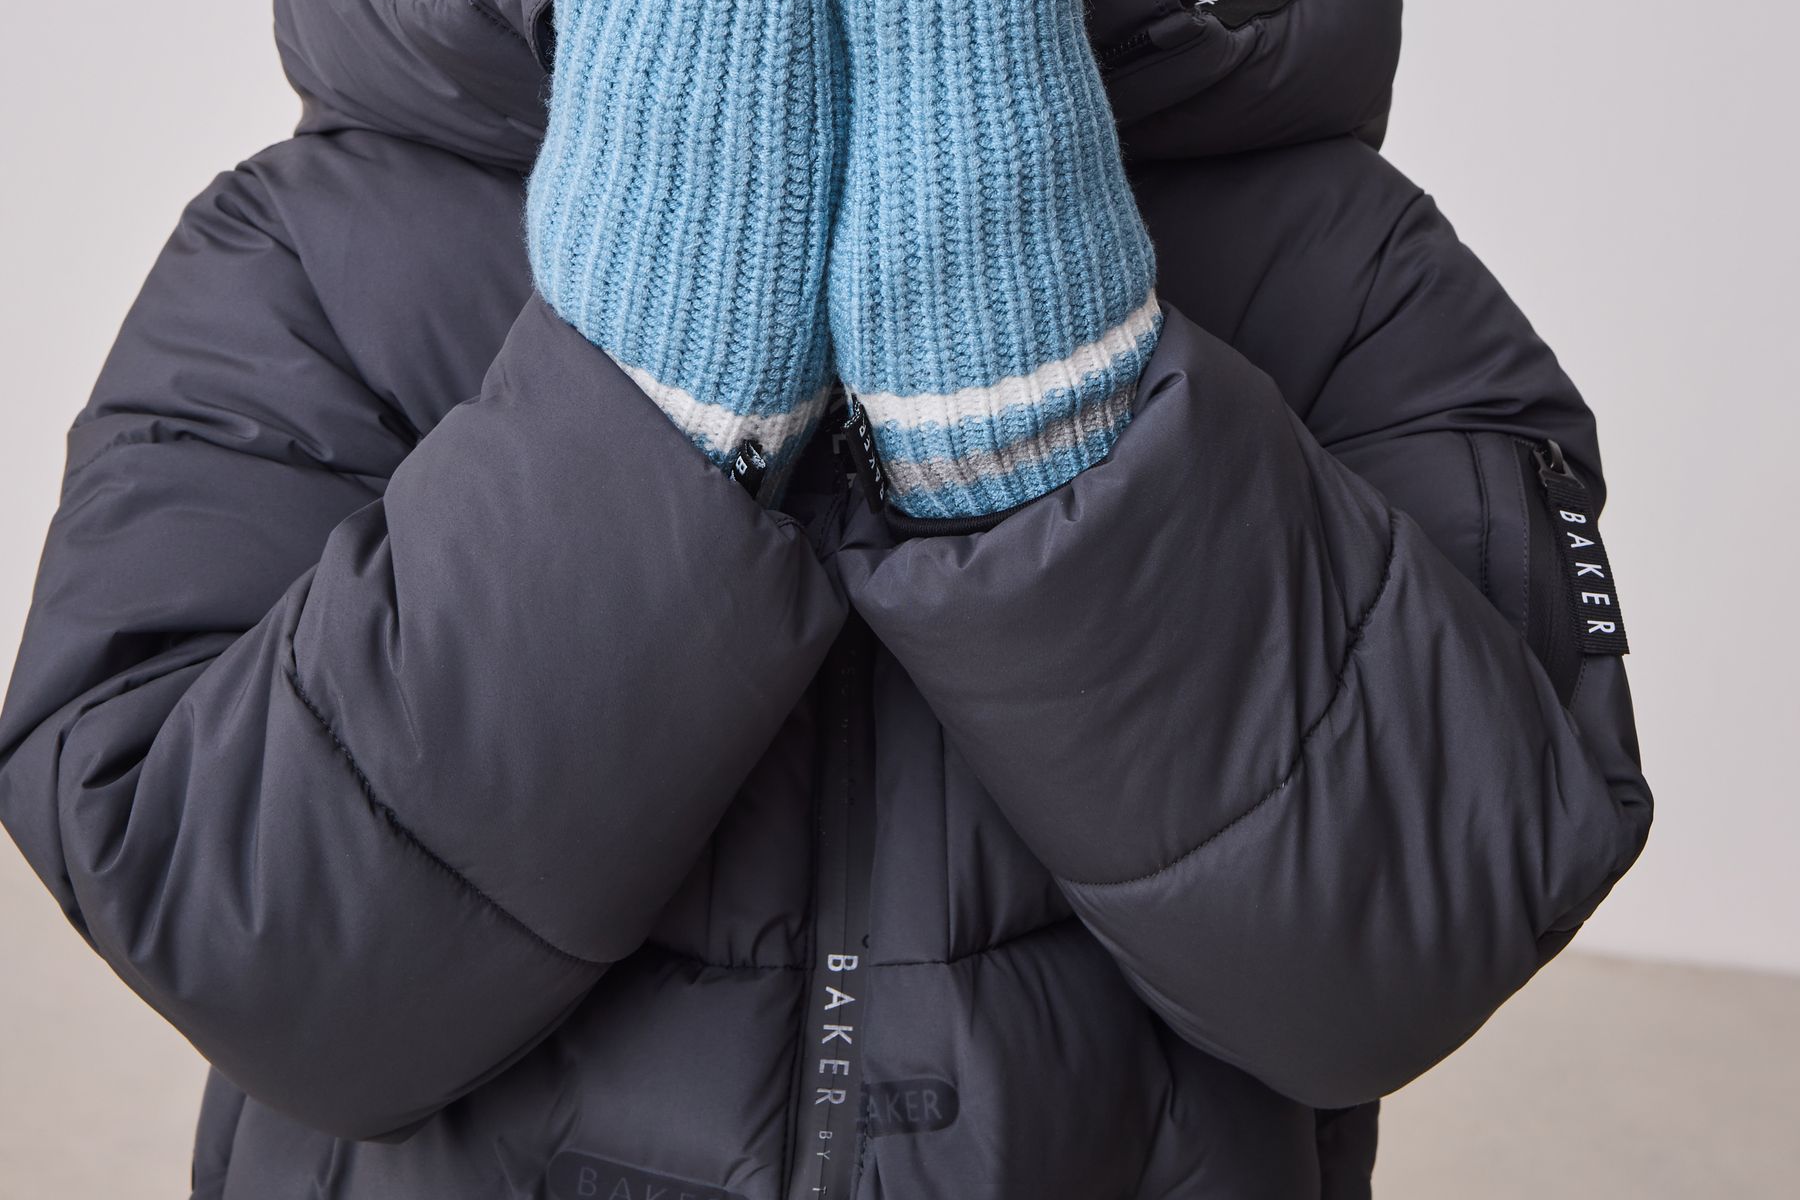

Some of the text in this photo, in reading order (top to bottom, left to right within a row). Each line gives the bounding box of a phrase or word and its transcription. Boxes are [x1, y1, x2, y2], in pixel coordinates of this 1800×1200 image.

[1559, 509, 1616, 634] BAKER
[815, 953, 859, 1105] BAKER
[816, 1130, 833, 1160] BY
[867, 1089, 943, 1122] AKER
